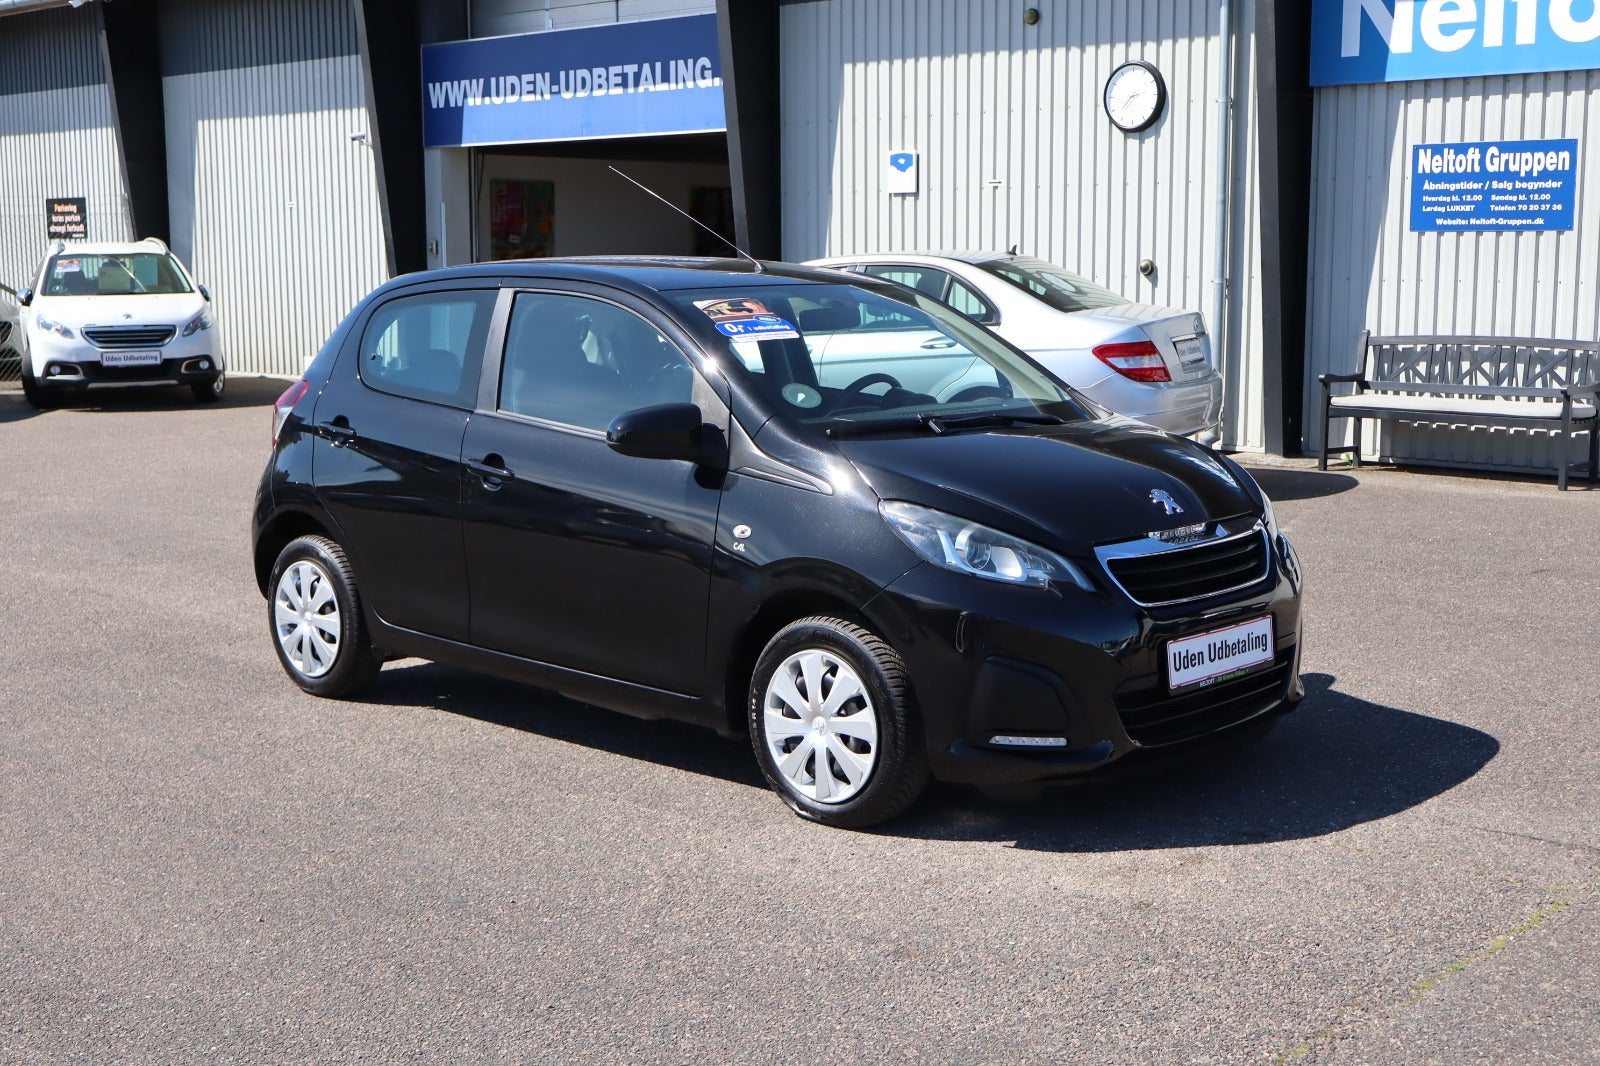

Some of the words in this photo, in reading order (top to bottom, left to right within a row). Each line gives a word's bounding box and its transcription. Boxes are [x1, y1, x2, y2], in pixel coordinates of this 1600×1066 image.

[428, 57, 723, 108] WWW.UDEN-UDBETALING.
[1418, 147, 1481, 174] Neltoft
[1485, 146, 1570, 177] Gruppen
[1423, 179, 1483, 191] Åbningstider
[1491, 181, 1513, 190] Salg
[1515, 180, 1562, 190] begynder
[1529, 193, 1551, 201] 12.00
[1436, 218, 1469, 226] Website:
[1469, 217, 1544, 226] Neltoft-Gruppen.dk
[124, 354, 158, 362] Udbetaling
[1173, 649, 1205, 672] Uden
[1207, 631, 1268, 663] Udbetaling
